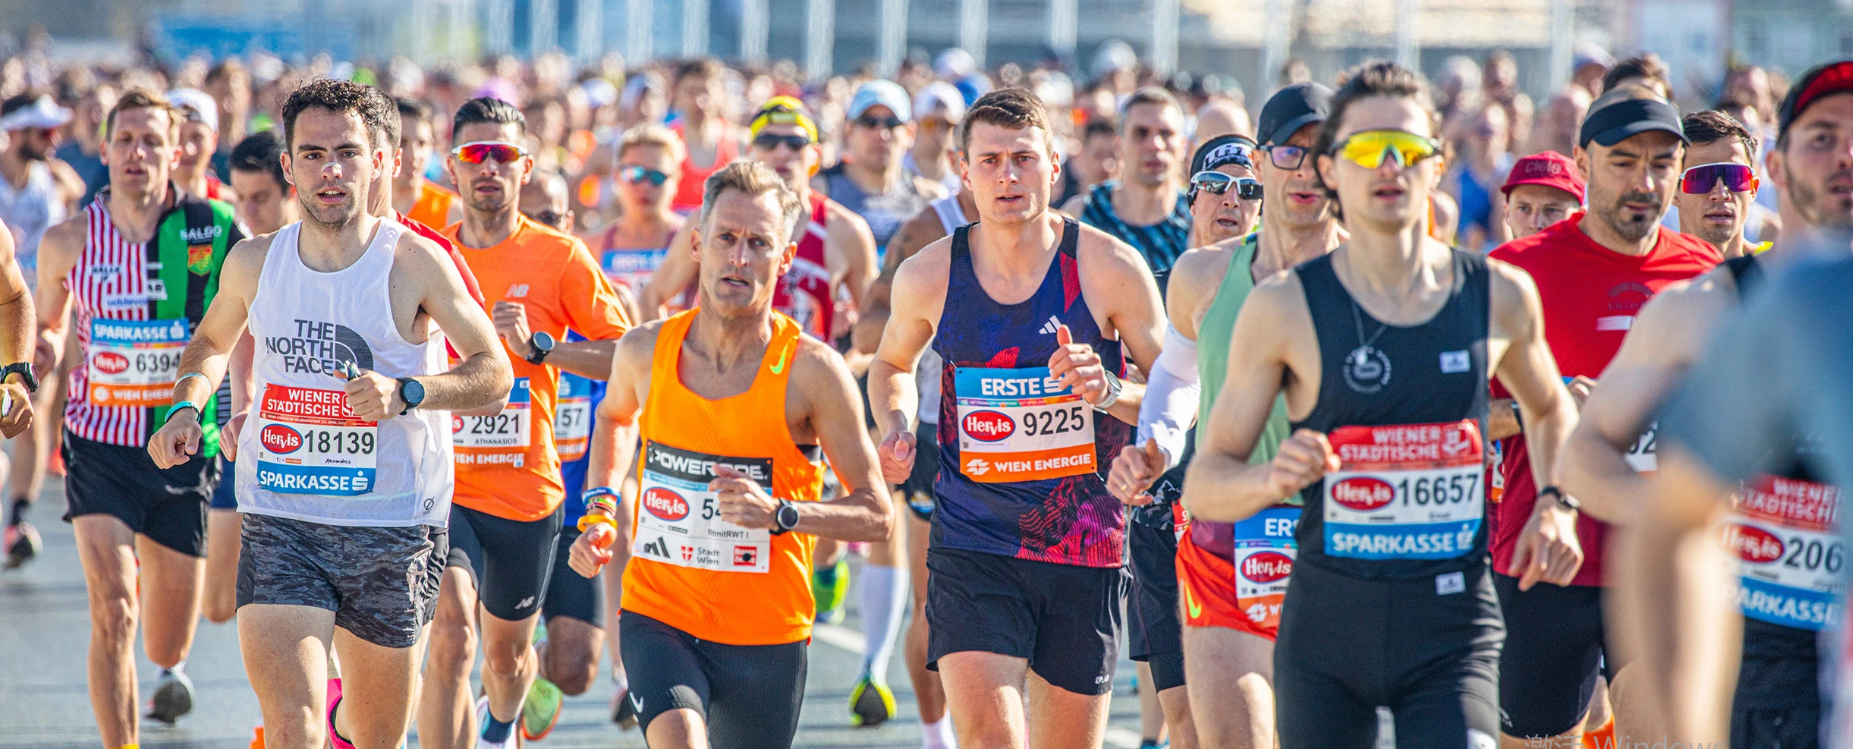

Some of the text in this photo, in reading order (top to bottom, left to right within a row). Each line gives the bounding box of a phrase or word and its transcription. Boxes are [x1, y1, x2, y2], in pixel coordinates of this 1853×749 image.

[180, 224, 223, 241] SALDO
[94, 323, 168, 340] SPARKASSE
[294, 319, 334, 341] THE
[265, 336, 334, 359] NORTH
[95, 353, 128, 372] Hervis
[136, 351, 181, 373] 6394
[284, 355, 334, 377] FACE
[113, 389, 140, 401] WIEN
[288, 388, 340, 404] WIENER
[981, 377, 1041, 396] ERSTE
[267, 398, 340, 417] STÄDTISCHE
[554, 408, 583, 427] 57
[471, 413, 519, 434] 2921
[966, 416, 1011, 436] Hervis
[1023, 406, 1085, 436] 9225
[263, 428, 299, 449] Hervis
[304, 429, 375, 455] 18139
[1372, 427, 1441, 444] WIENER
[994, 453, 1092, 473] WIEN ENERGIE
[260, 470, 350, 491] SPARKASSE
[1397, 473, 1479, 507] 16657
[646, 490, 687, 516] Hervis
[1335, 481, 1392, 506] Hervis
[1332, 530, 1454, 555] SPARKASSE
[1721, 523, 1781, 559] Hervis
[697, 547, 720, 557] Stadt
[697, 555, 720, 565] Wien
[1245, 557, 1292, 577] Hervis
